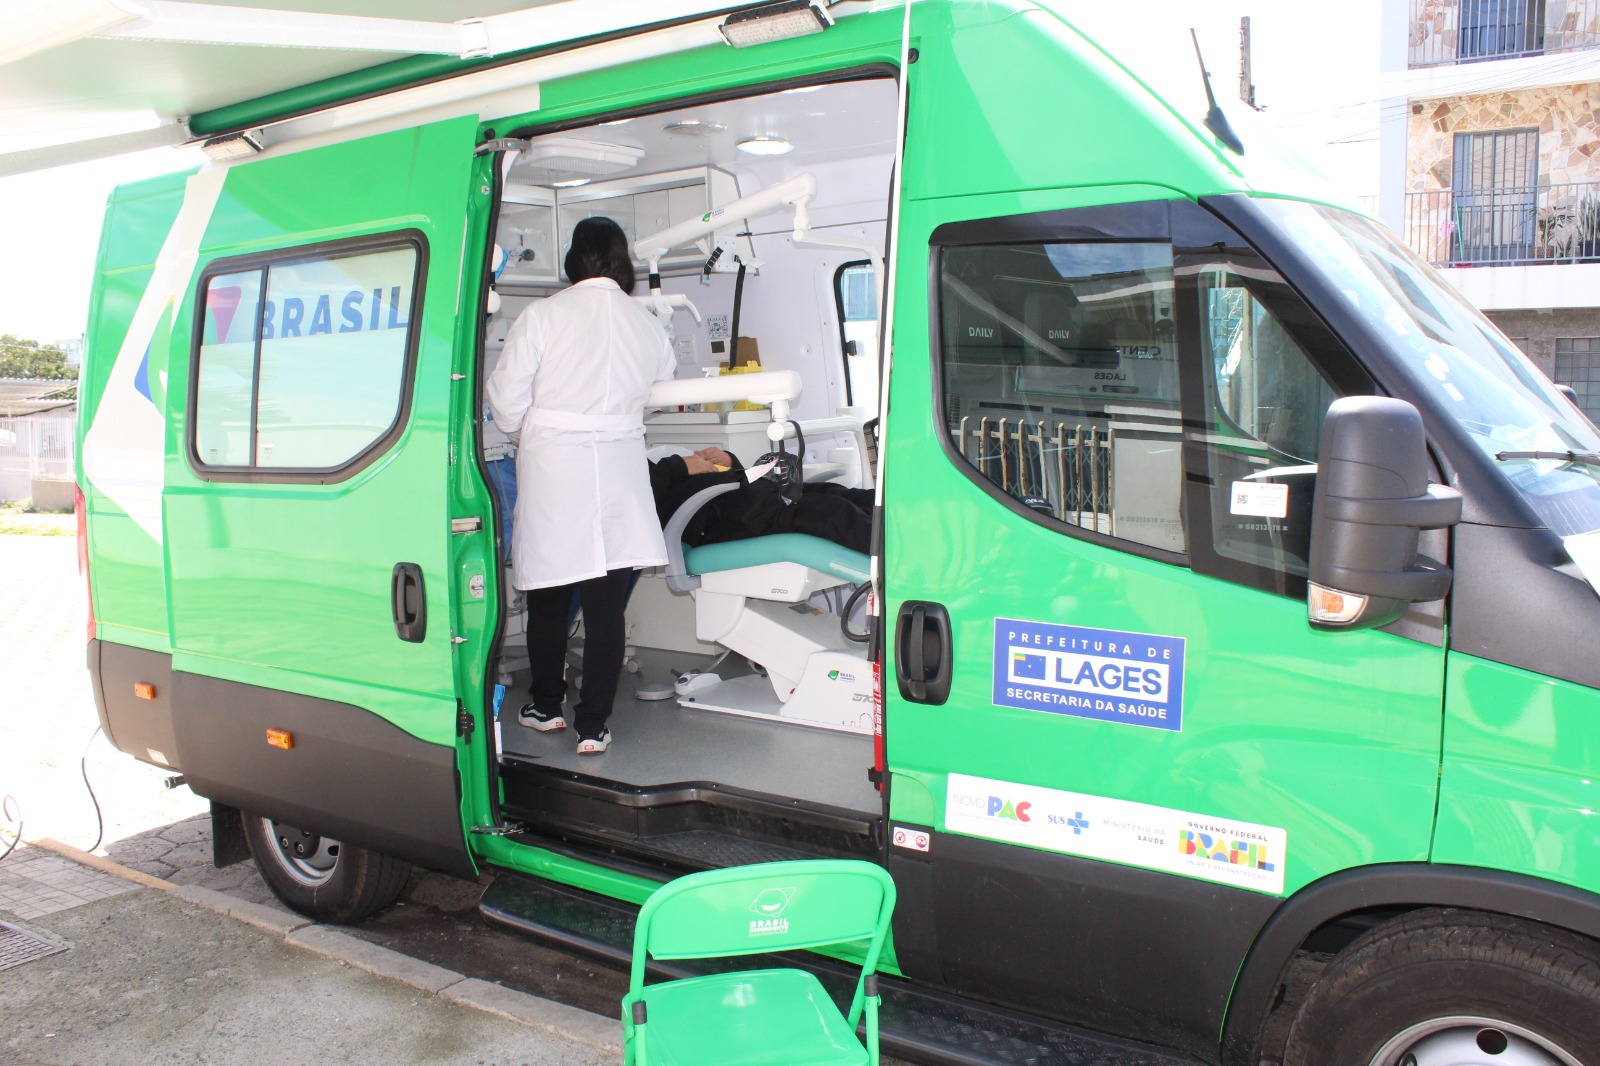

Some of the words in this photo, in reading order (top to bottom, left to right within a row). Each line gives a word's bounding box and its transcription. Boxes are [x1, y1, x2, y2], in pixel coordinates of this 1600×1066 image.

[254, 286, 409, 341] BRASIL
[968, 326, 994, 338] DAILY
[1048, 330, 1070, 339] DAILY
[1009, 631, 1131, 655] PREFEITURA
[1147, 647, 1171, 660] DE
[1055, 657, 1162, 696] LAGES
[1007, 688, 1092, 709] SECRETARIA
[1095, 700, 1115, 712] DA
[1118, 703, 1167, 719] SAÚDE
[953, 794, 986, 808] NOVO
[987, 795, 1032, 823] PAC
[1047, 814, 1065, 825] SUS
[1188, 821, 1227, 834] GOVERNO
[1230, 829, 1268, 842] FEDERAL
[1178, 829, 1275, 872] BRASIL
[1213, 864, 1266, 880] RECONSTRUÇÃO
[749, 918, 789, 928] BRASIL
